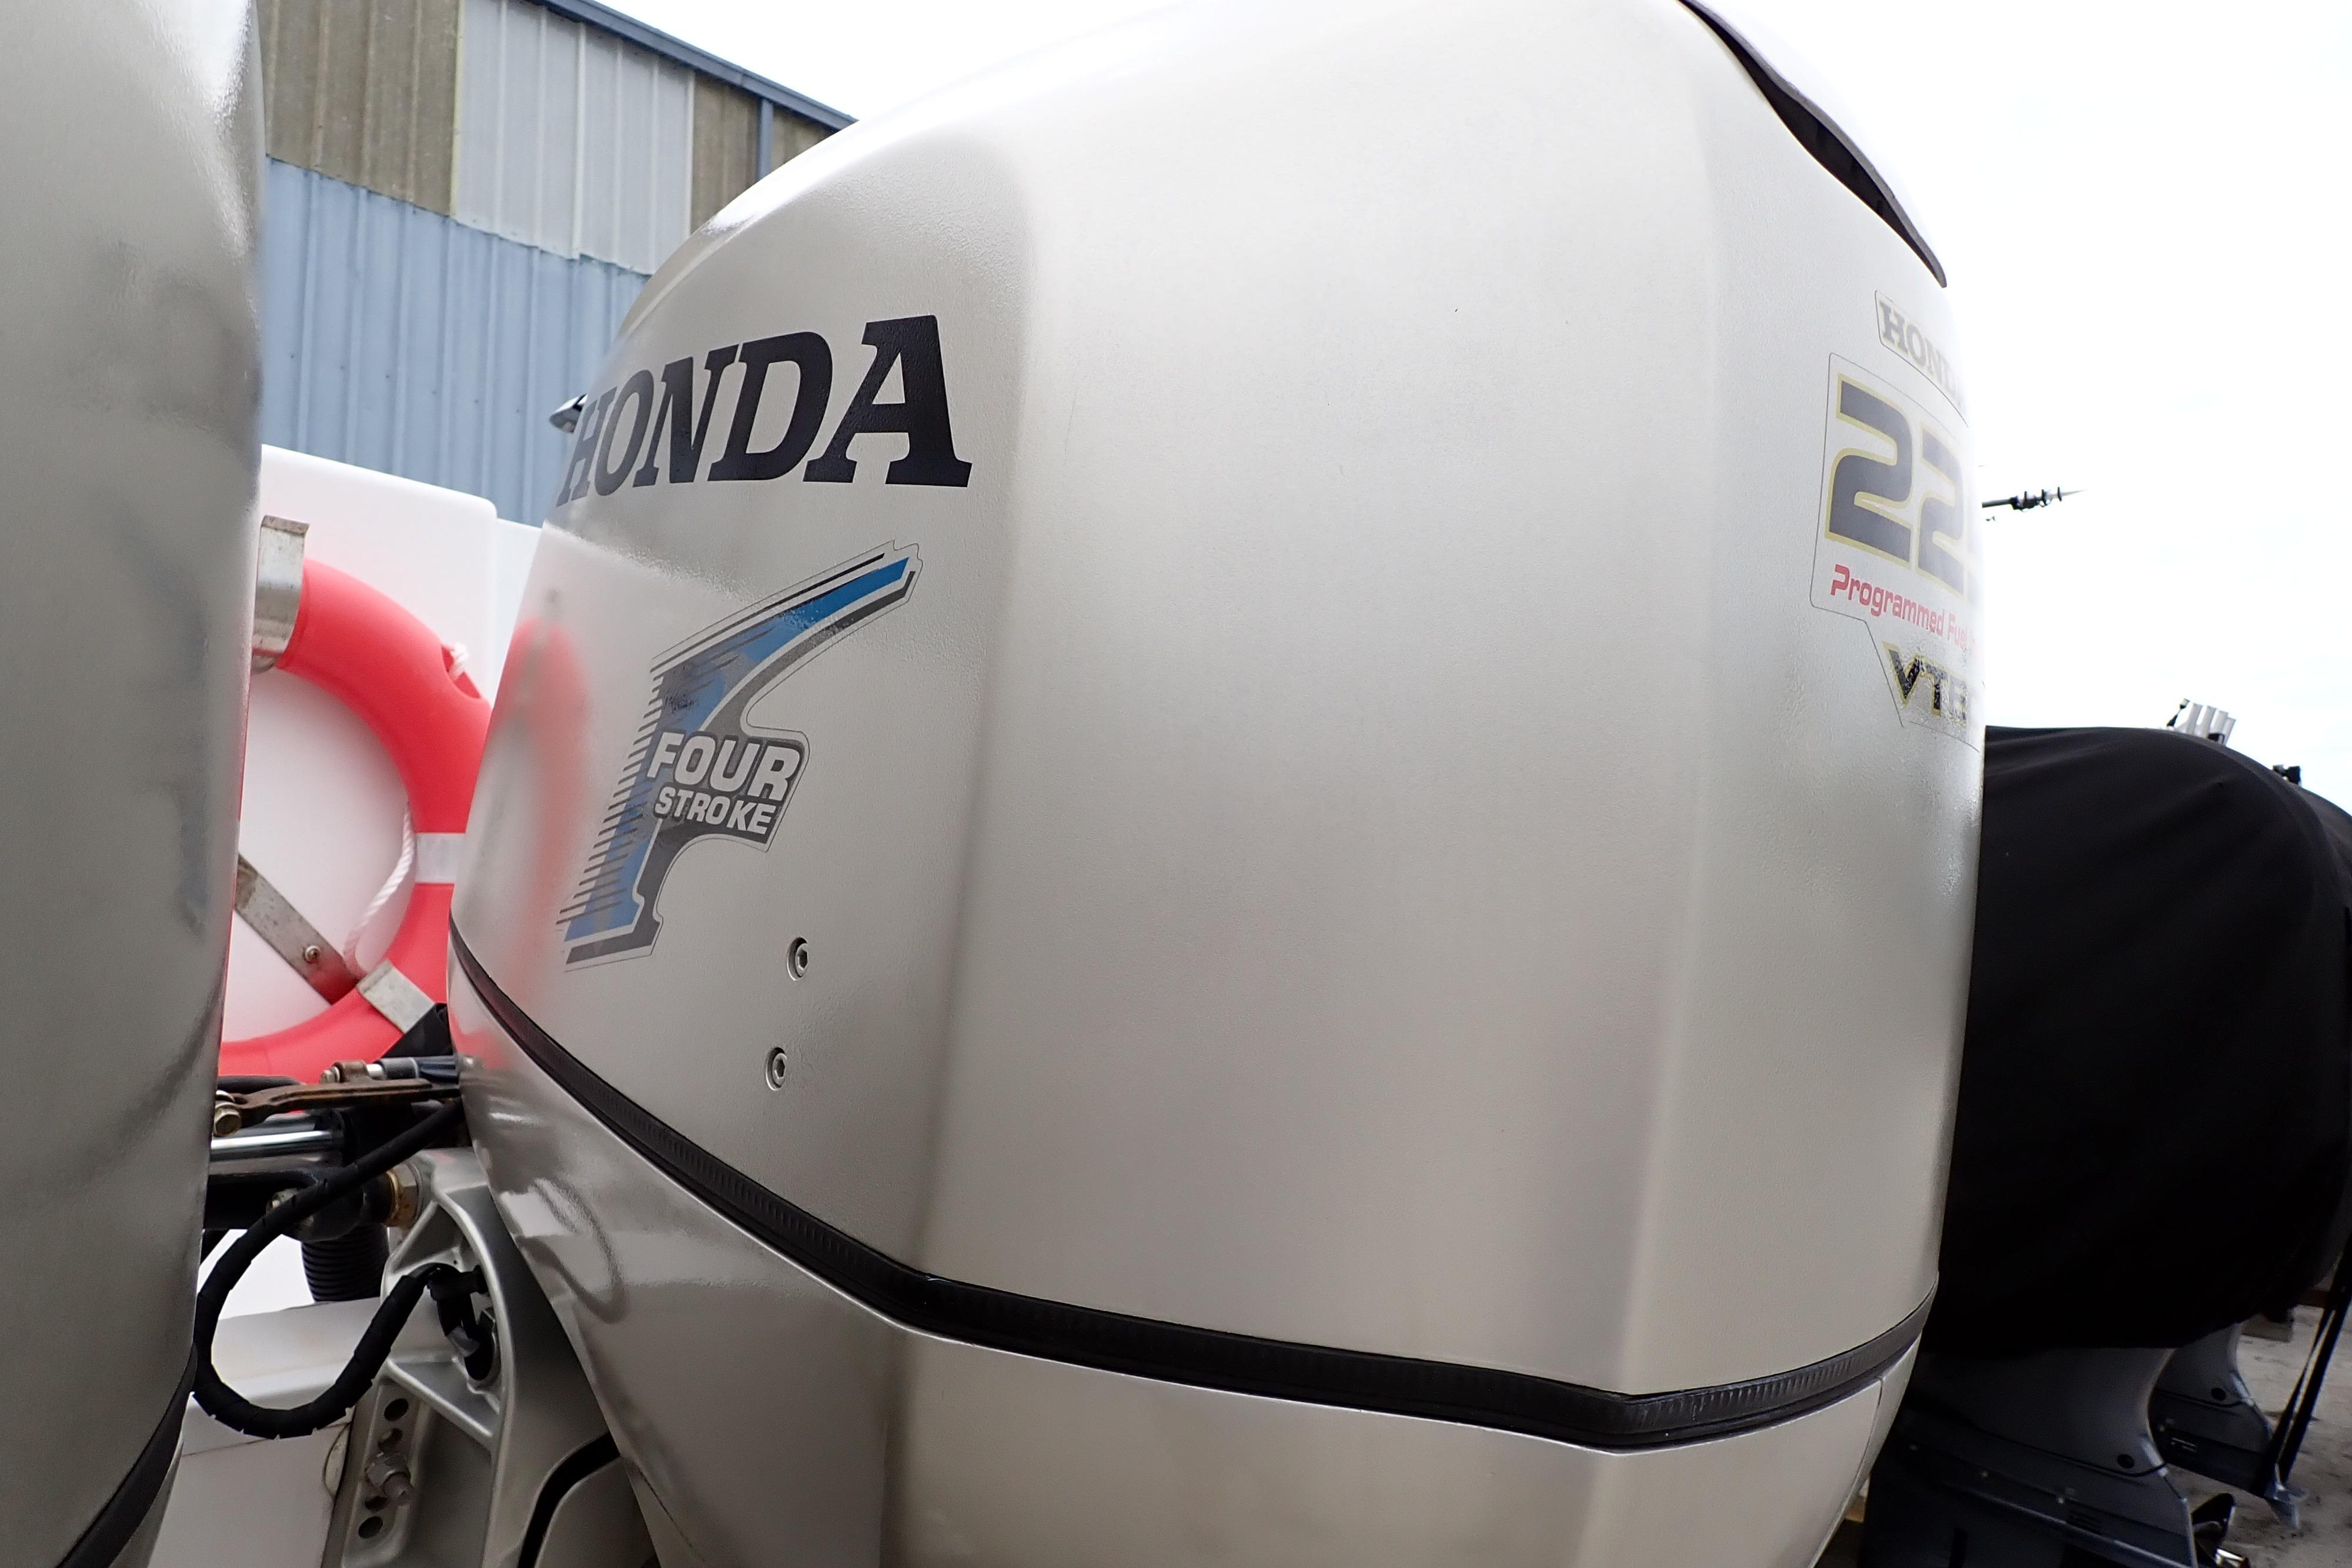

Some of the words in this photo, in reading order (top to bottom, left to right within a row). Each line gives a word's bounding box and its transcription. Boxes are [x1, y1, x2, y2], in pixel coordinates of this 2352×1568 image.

[556, 315, 973, 508] HONDA
[1830, 563, 1945, 637] Programmed
[1947, 612, 1967, 651] Fuel
[1883, 640, 1973, 727] VTE
[647, 731, 800, 801] FOUR
[654, 787, 776, 834] STROKE
